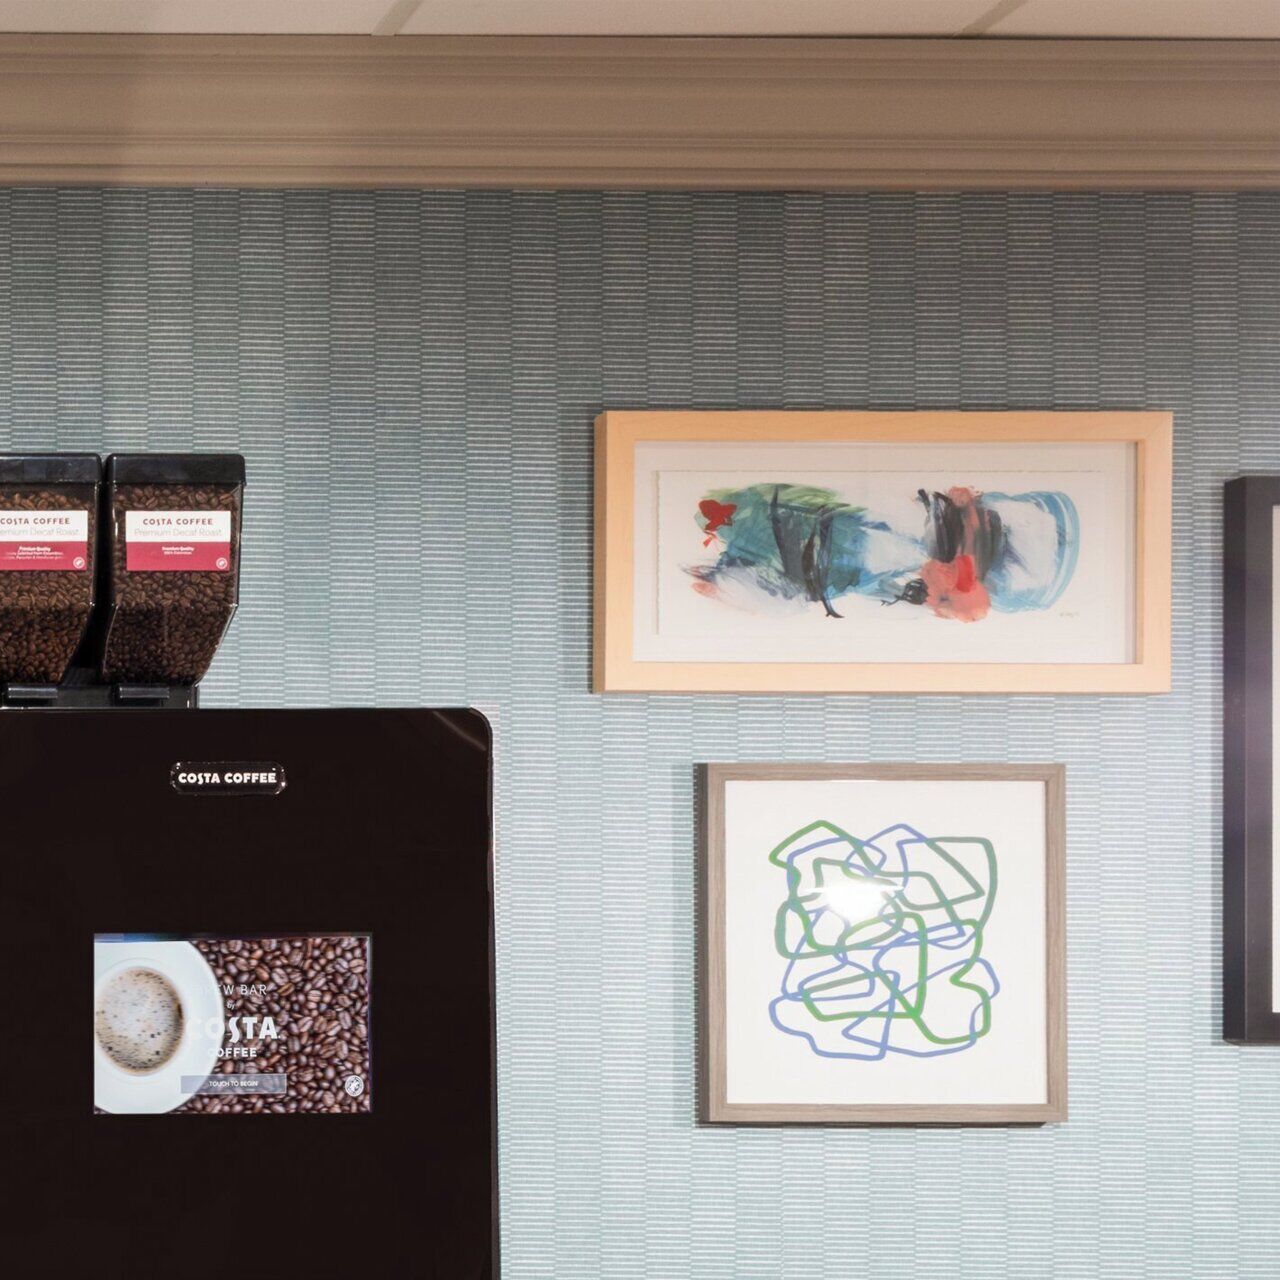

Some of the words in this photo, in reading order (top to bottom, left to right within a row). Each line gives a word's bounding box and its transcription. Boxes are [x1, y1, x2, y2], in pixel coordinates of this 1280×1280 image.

[143, 518, 172, 526] COSTA
[178, 772, 221, 785] COSTA
[224, 771, 277, 784] COFFEE
[240, 984, 267, 996] BAR
[240, 1079, 259, 1087] BEGIN
